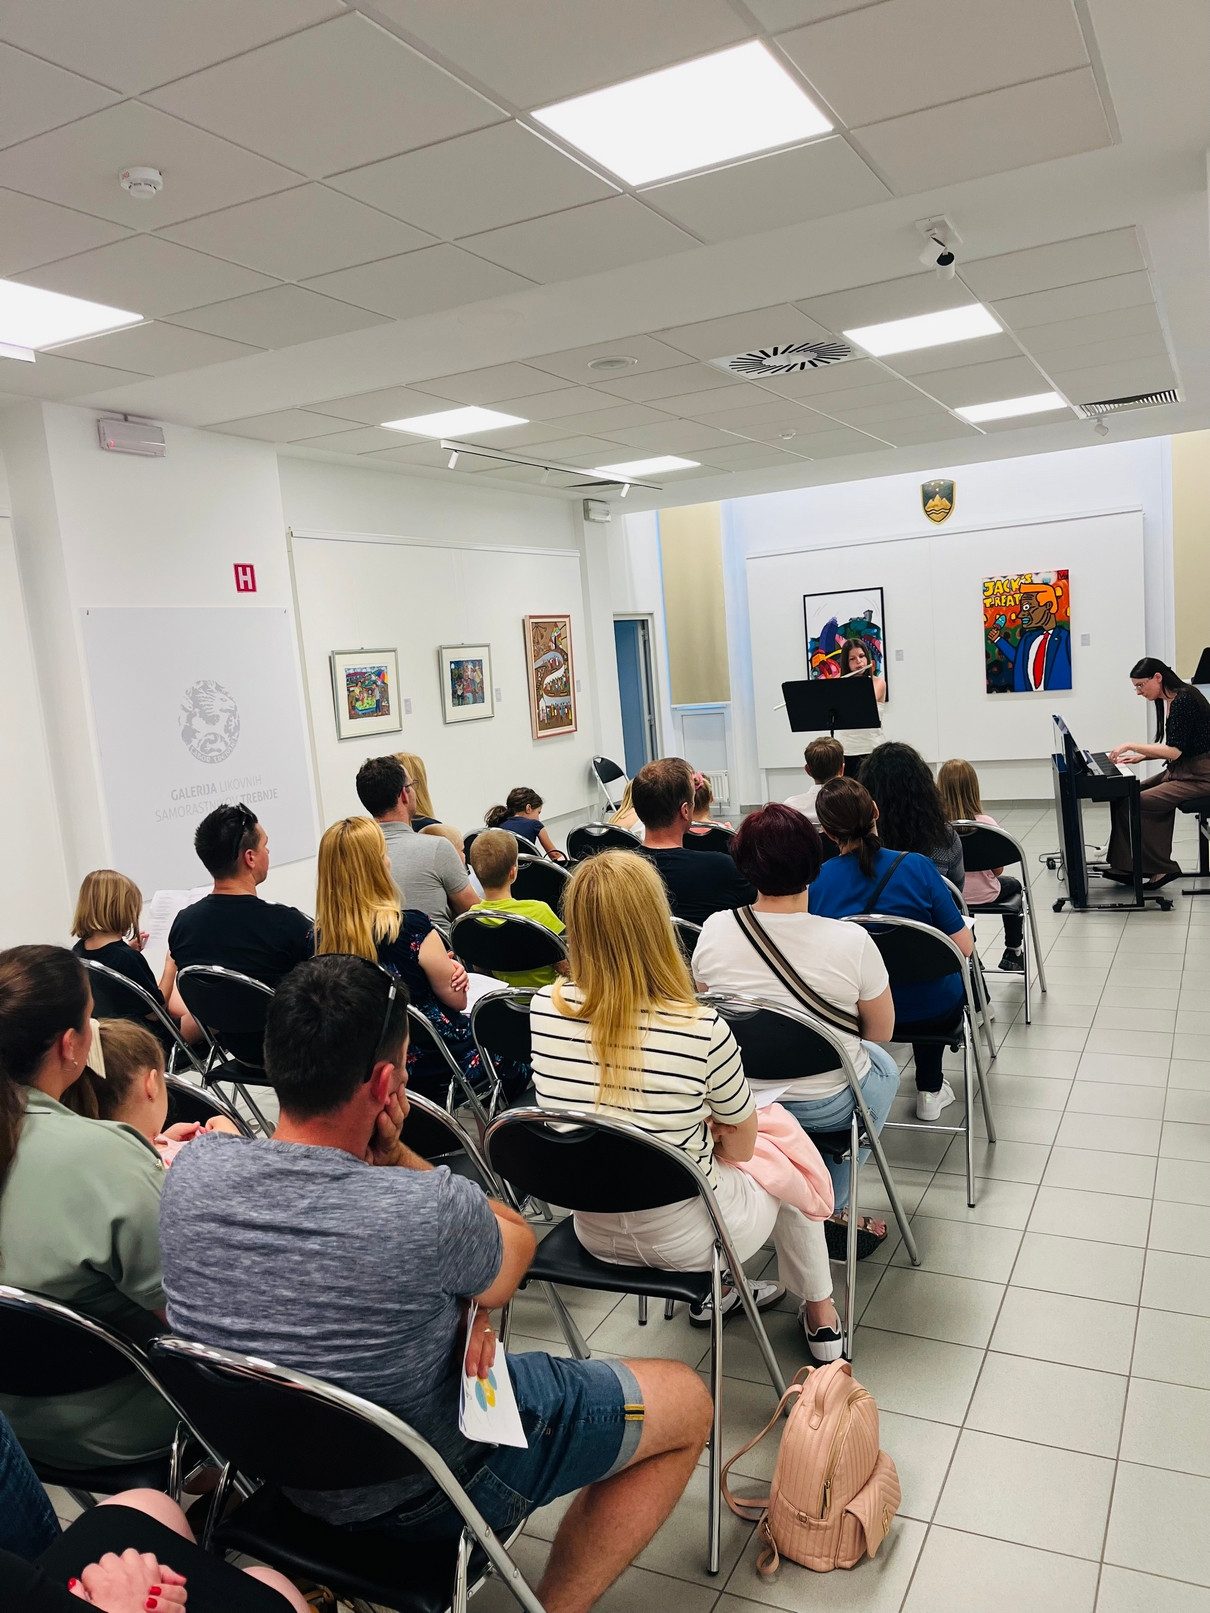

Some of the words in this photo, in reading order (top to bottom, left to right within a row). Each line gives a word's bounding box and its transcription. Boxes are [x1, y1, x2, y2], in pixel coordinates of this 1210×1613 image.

[983, 573, 1032, 596] JACK'S
[170, 783, 217, 801] GALERIJA
[219, 775, 262, 793] LIKOVNIH
[240, 788, 279, 805] TREBNJE
